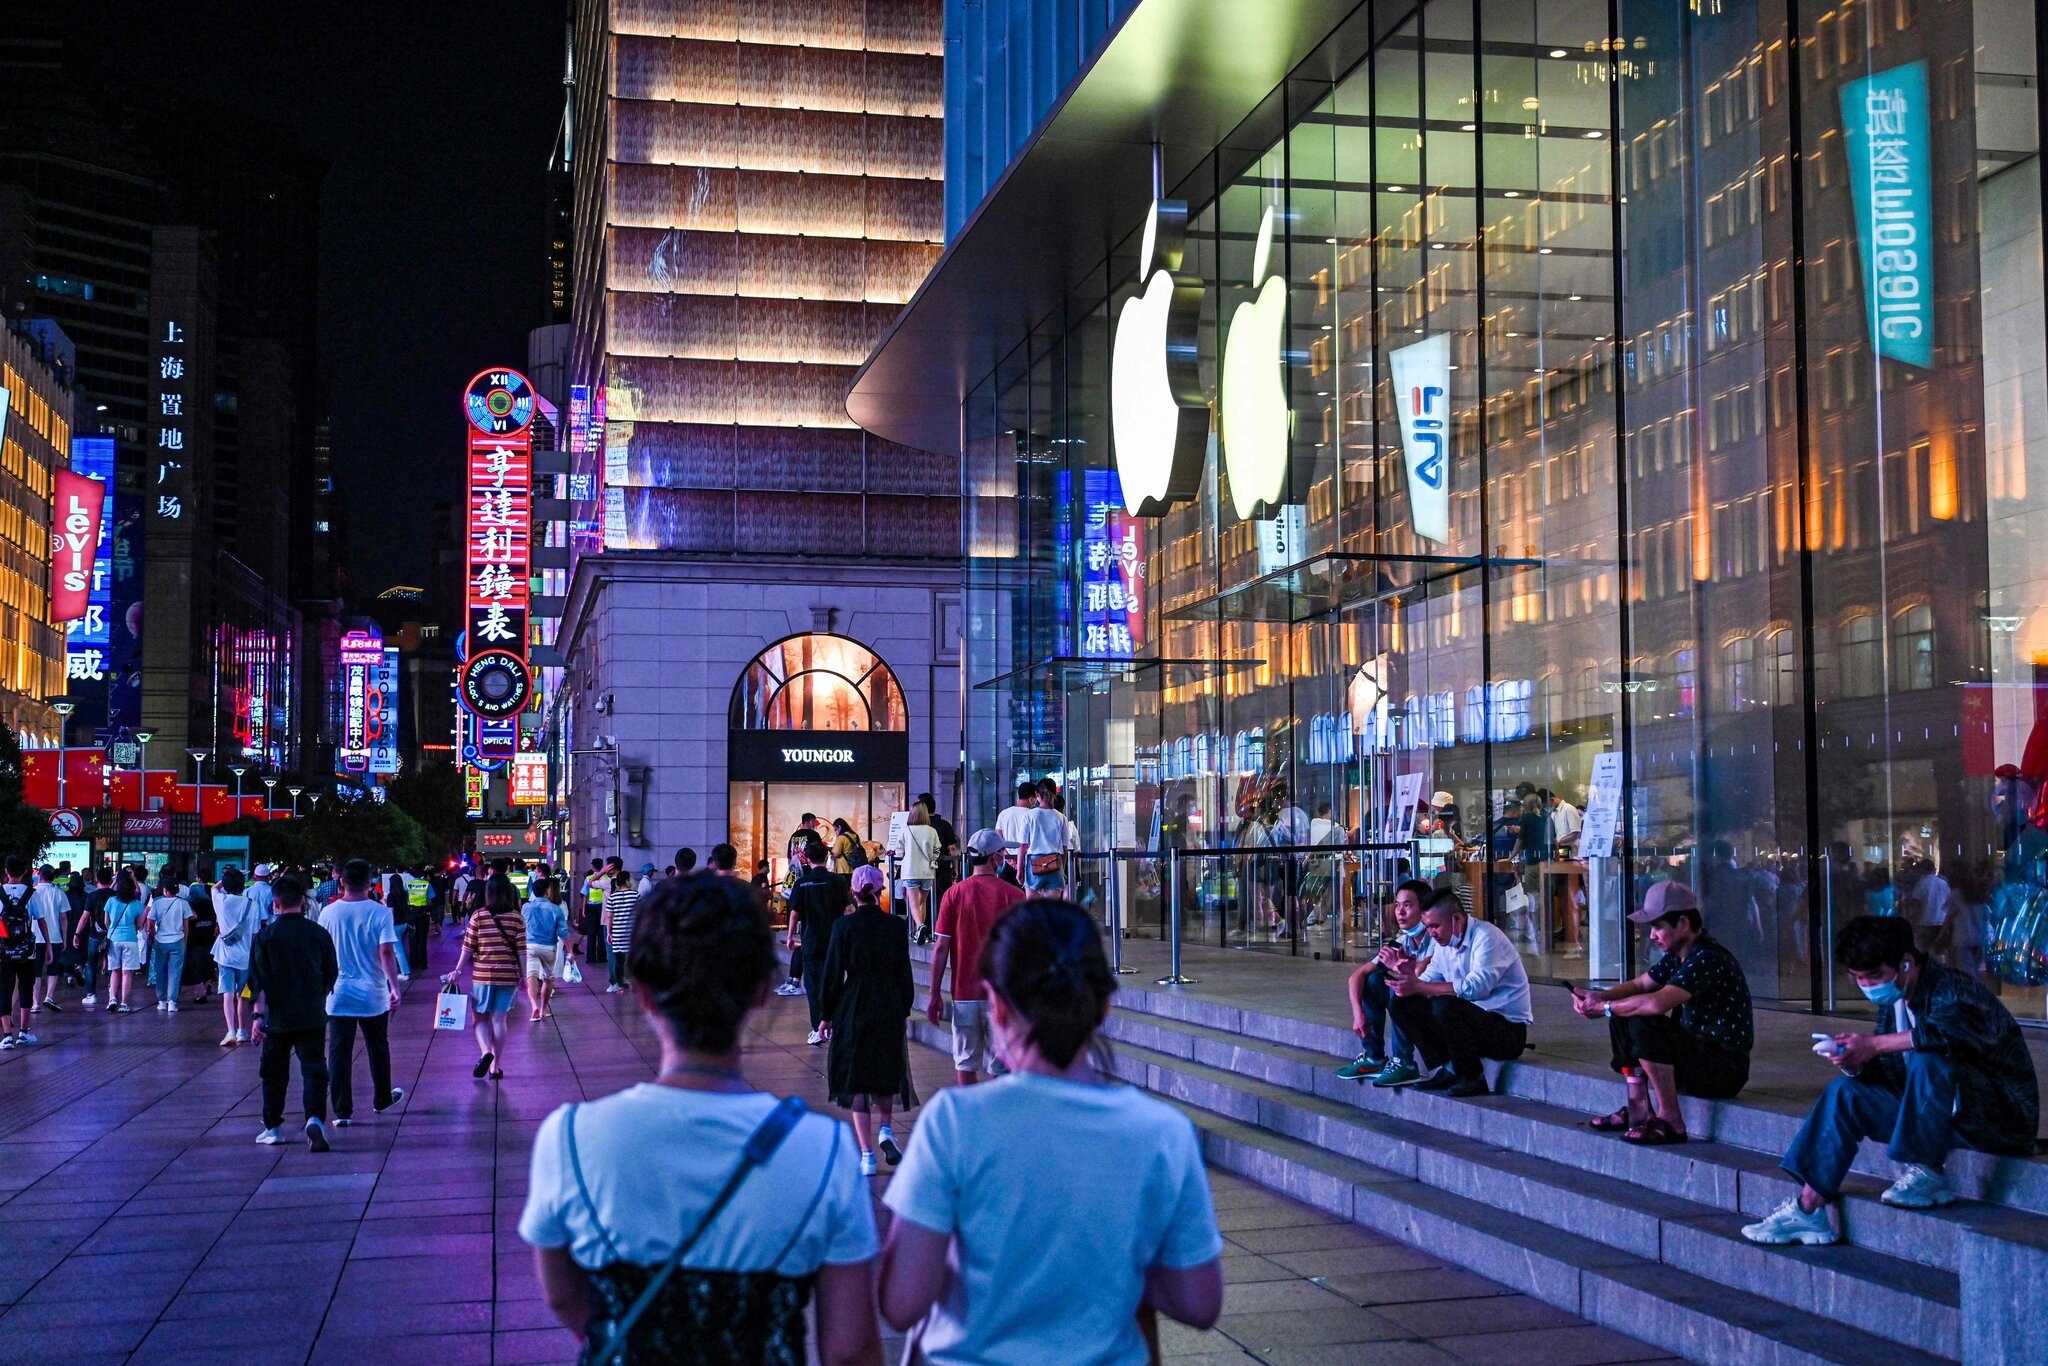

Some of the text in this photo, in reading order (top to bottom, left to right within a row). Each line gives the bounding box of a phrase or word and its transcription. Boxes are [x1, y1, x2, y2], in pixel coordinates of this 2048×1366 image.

[490, 374, 509, 386] XII
[157, 321, 185, 519] 上海置地广场
[493, 420, 507, 431] VI
[470, 656, 522, 678] HENG DALI
[501, 682, 524, 710] WATCHES
[483, 737, 513, 746] OPTICAL
[782, 749, 855, 763] YOUNGOR
